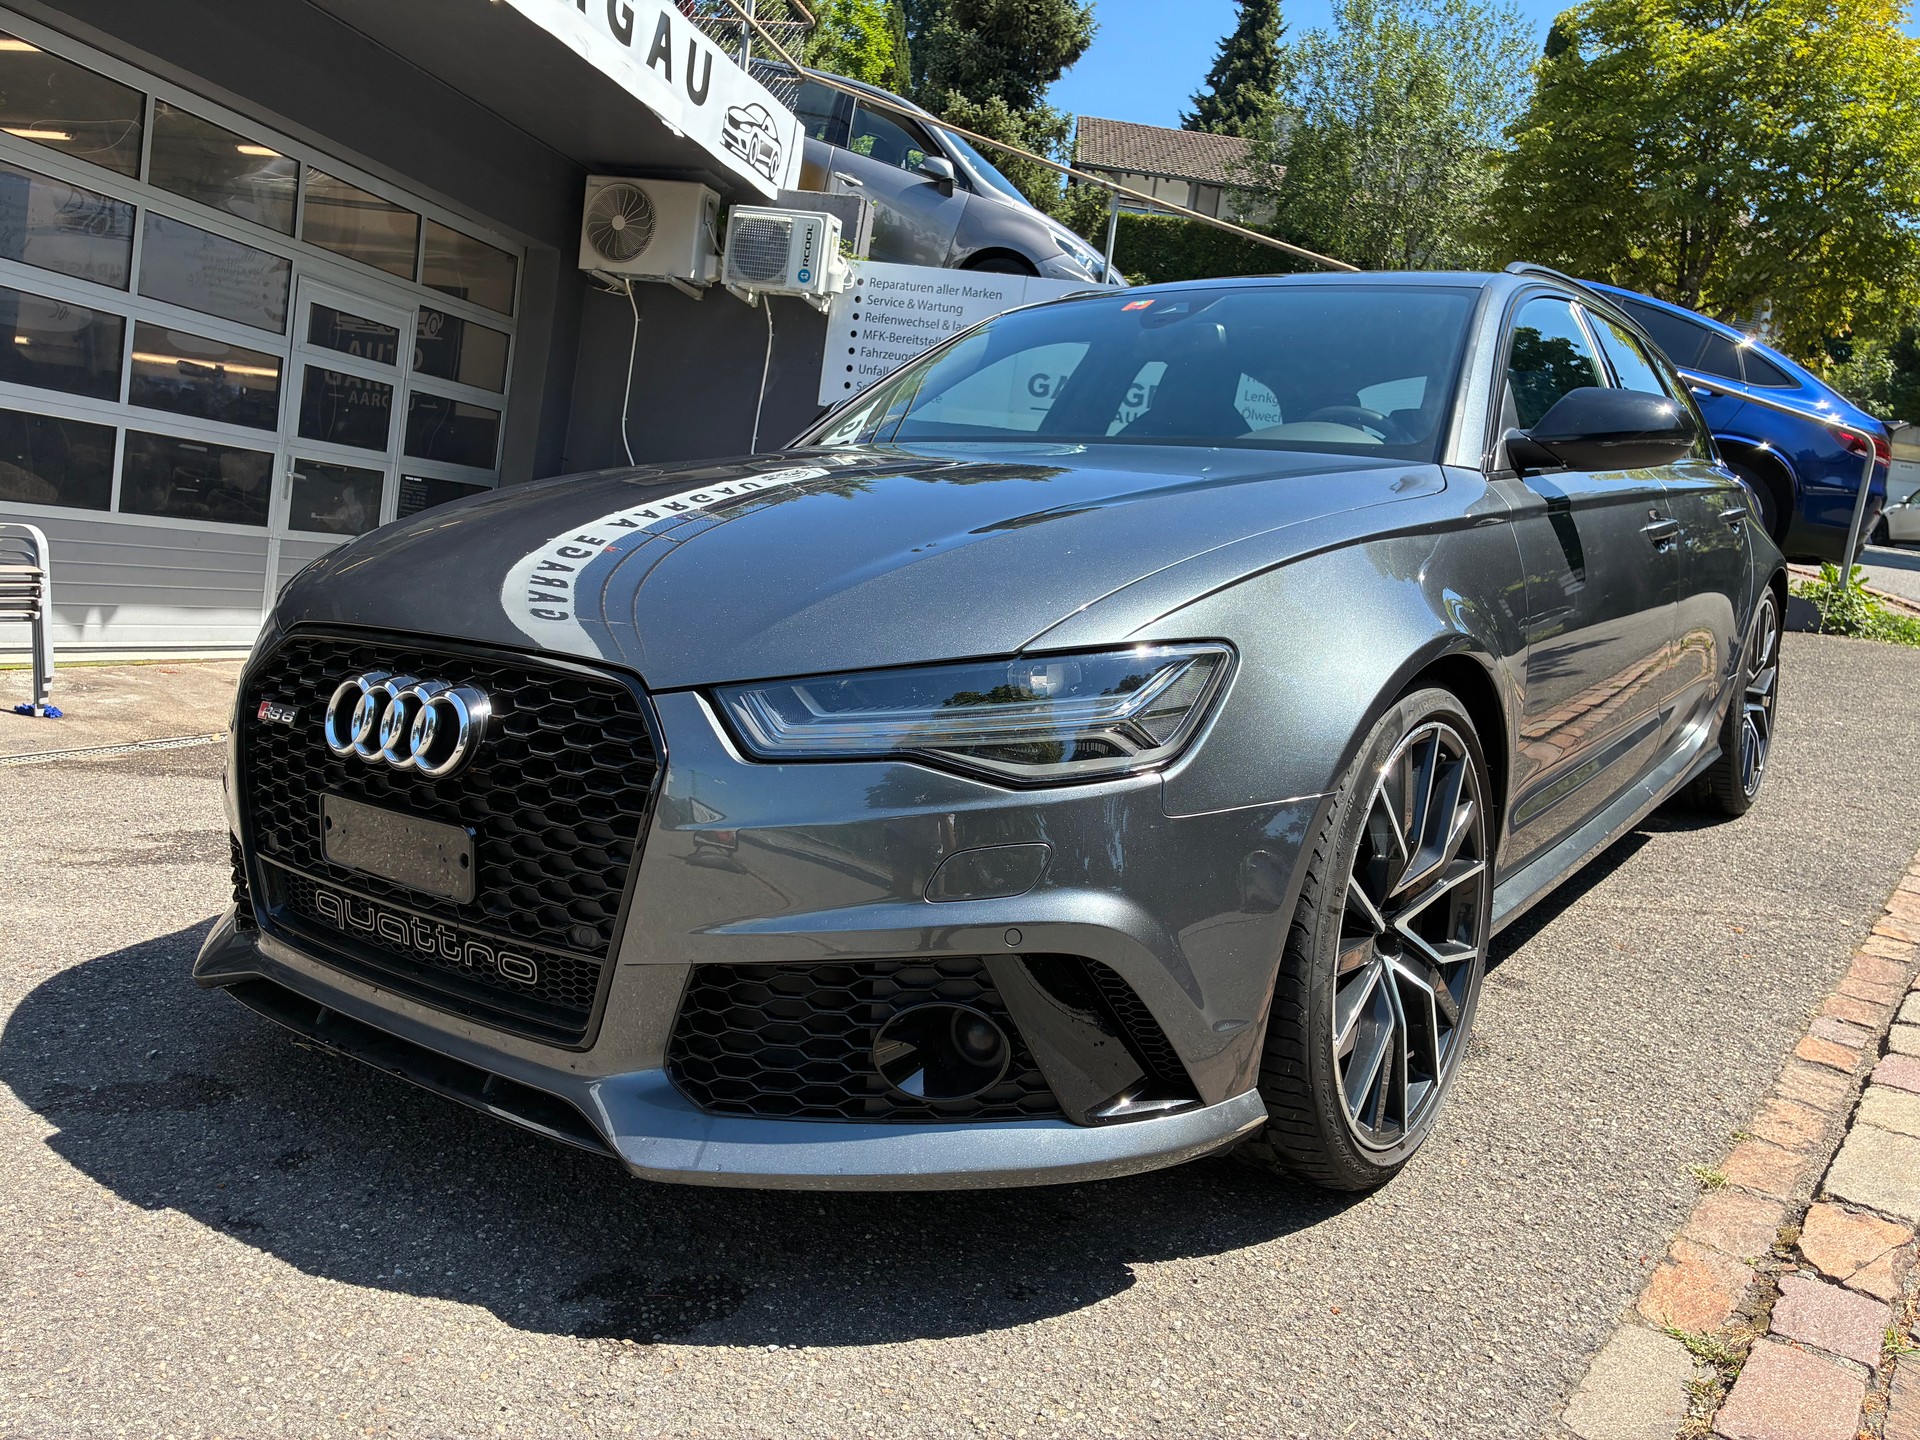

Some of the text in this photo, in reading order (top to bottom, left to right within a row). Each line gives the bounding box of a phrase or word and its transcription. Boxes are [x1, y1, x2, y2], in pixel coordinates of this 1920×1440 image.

[577, 0, 713, 107] GAU
[802, 224, 814, 267] RCOOL
[867, 294, 963, 316] Service & Wartung
[869, 277, 1003, 300] Reparaturen aller Marken
[864, 312, 940, 330] Reifenwechsel
[941, 320, 951, 331] &
[315, 889, 538, 985] quattro
